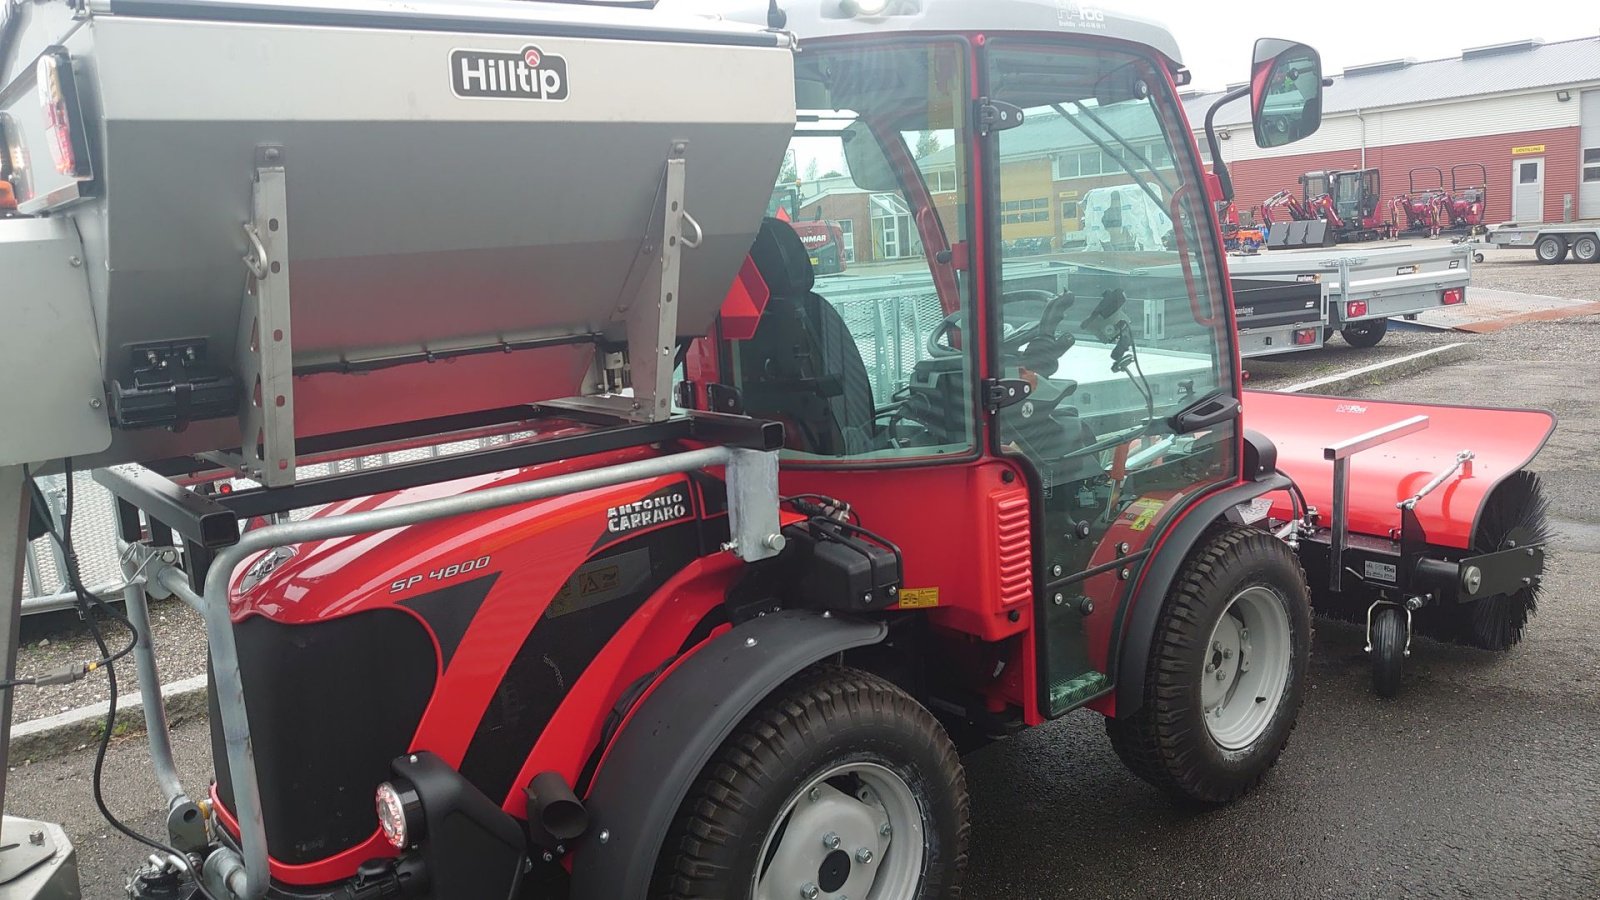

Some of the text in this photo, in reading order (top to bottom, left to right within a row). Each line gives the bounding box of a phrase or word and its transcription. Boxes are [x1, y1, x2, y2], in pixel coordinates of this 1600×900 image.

[461, 49, 561, 100] Hilltip
[607, 493, 683, 518] ANTONIO
[608, 504, 686, 533] CARRARO
[389, 555, 491, 594] SP 4800
